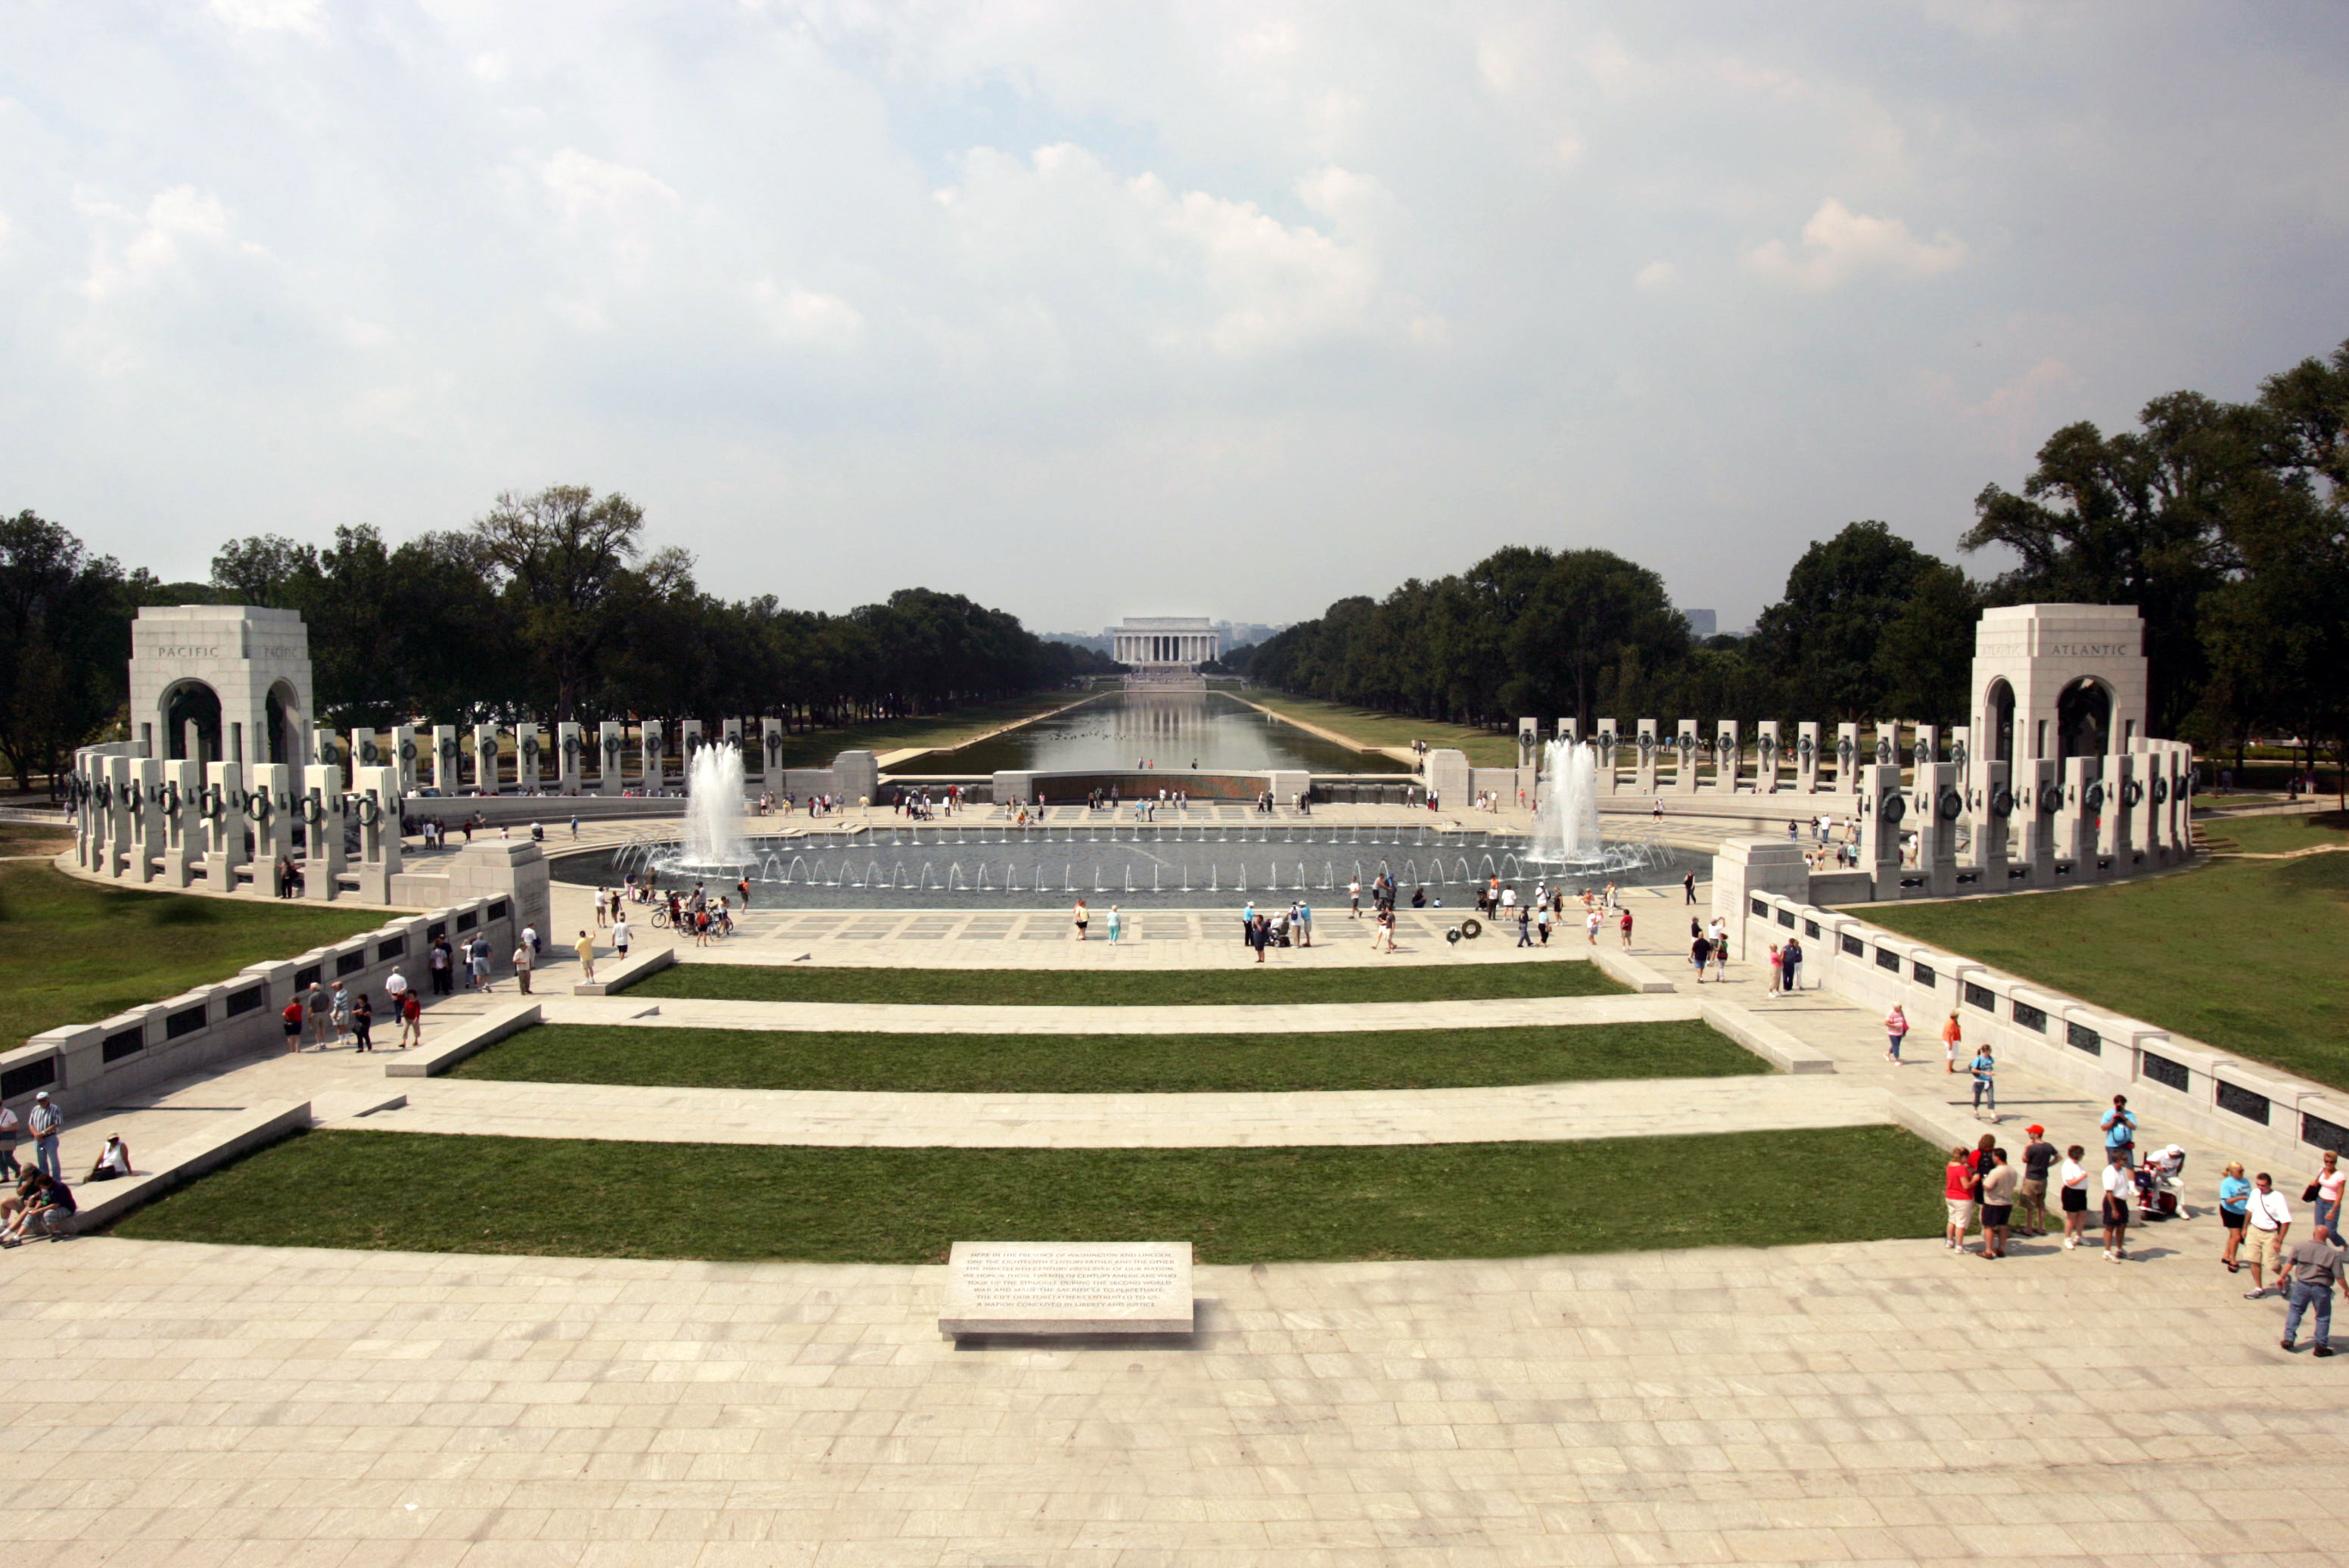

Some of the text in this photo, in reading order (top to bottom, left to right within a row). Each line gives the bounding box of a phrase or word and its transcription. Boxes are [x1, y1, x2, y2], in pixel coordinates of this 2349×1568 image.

[158, 646, 219, 658] PACIFIC
[264, 647, 297, 658] PACIFIC
[1982, 645, 2021, 655] ATLANTIC
[2052, 645, 2127, 655] ATLANTIC
